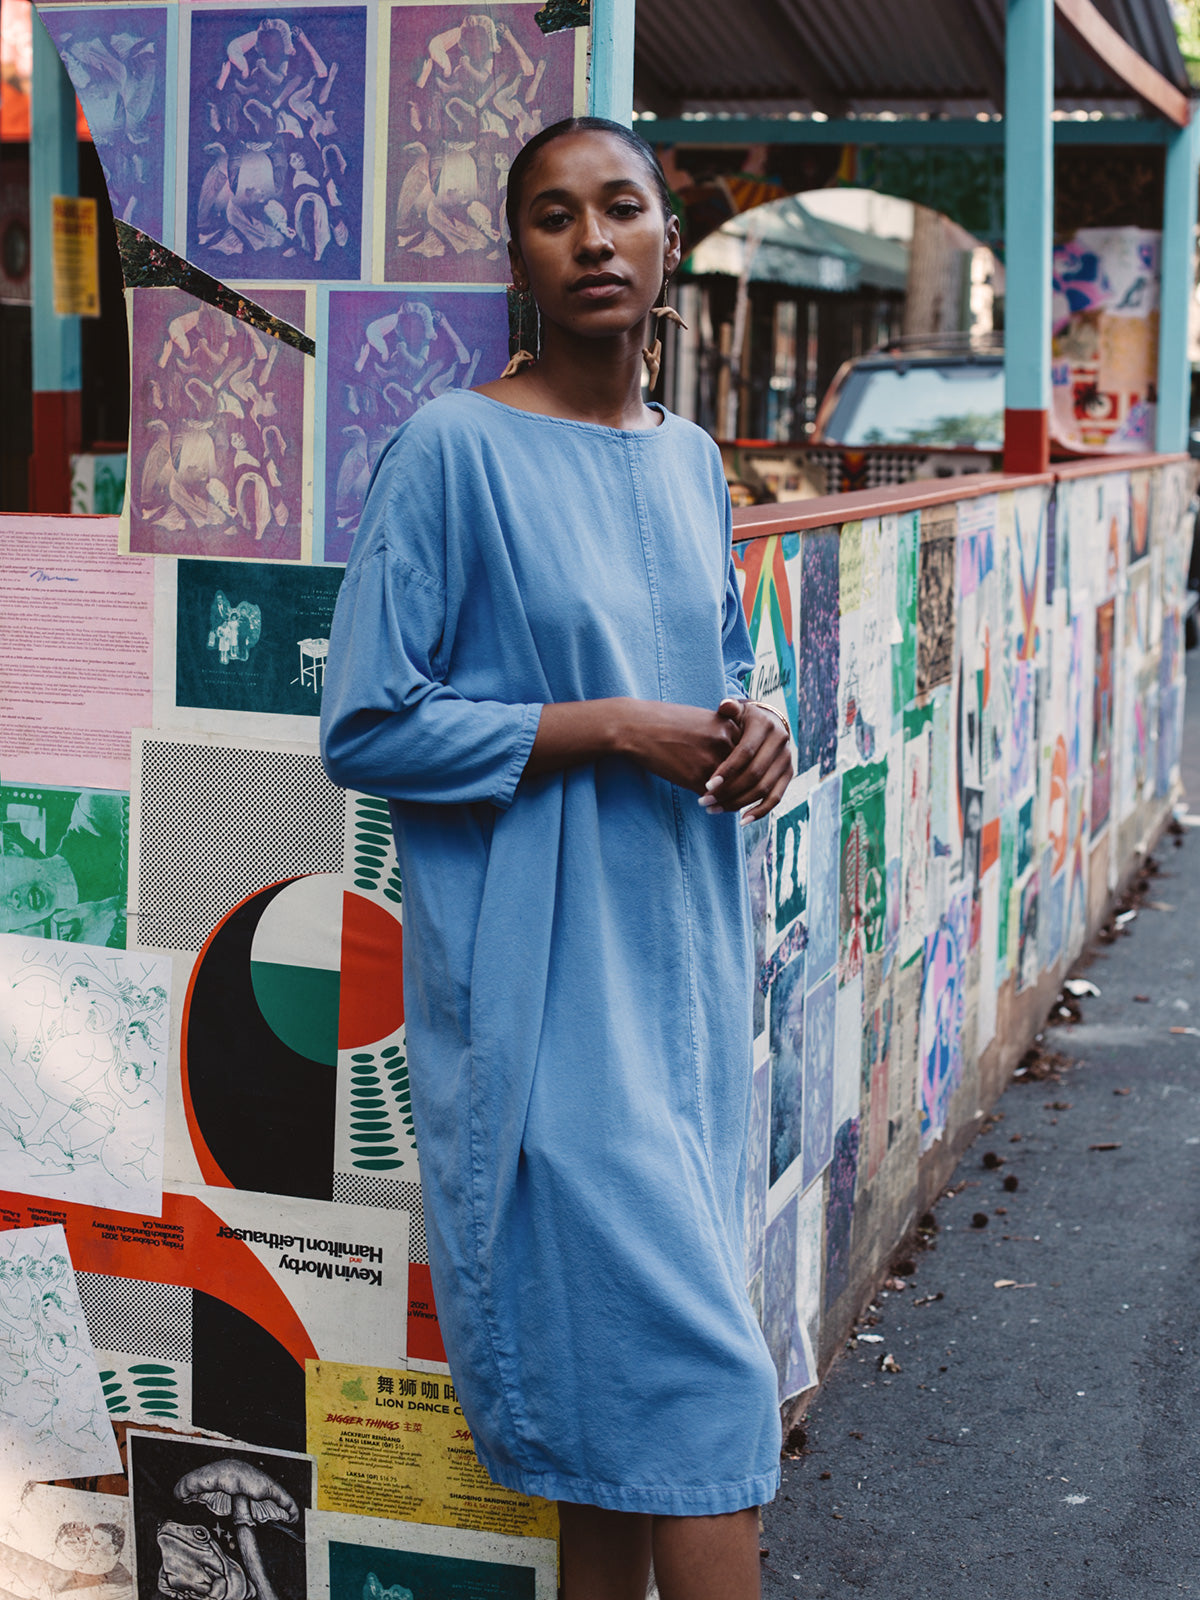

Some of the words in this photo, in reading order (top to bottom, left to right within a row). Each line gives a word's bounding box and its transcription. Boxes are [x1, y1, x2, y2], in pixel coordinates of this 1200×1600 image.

[92, 1220, 116, 1232] Winery
[142, 1221, 153, 1229] CA
[101, 1232, 118, 1241] 2021
[131, 1236, 160, 1247] October
[216, 1225, 304, 1253] Leithauser
[161, 1239, 184, 1250] Friday,
[306, 1238, 383, 1263] Hamilton
[349, 1256, 362, 1264] and
[279, 1253, 333, 1280] Morby
[335, 1264, 383, 1287] Kevin
[410, 1300, 428, 1310] 2021
[376, 1397, 403, 1409] LION
[408, 1401, 449, 1414] DANCE
[454, 1406, 464, 1416] C
[325, 1412, 363, 1427] BIGGER
[365, 1417, 400, 1432] THINGS
[341, 1431, 370, 1439] JACKFRUIT
[372, 1435, 401, 1443] RENDANG
[450, 1493, 482, 1502] SHAOBING
[484, 1497, 517, 1507] SANDWICH
